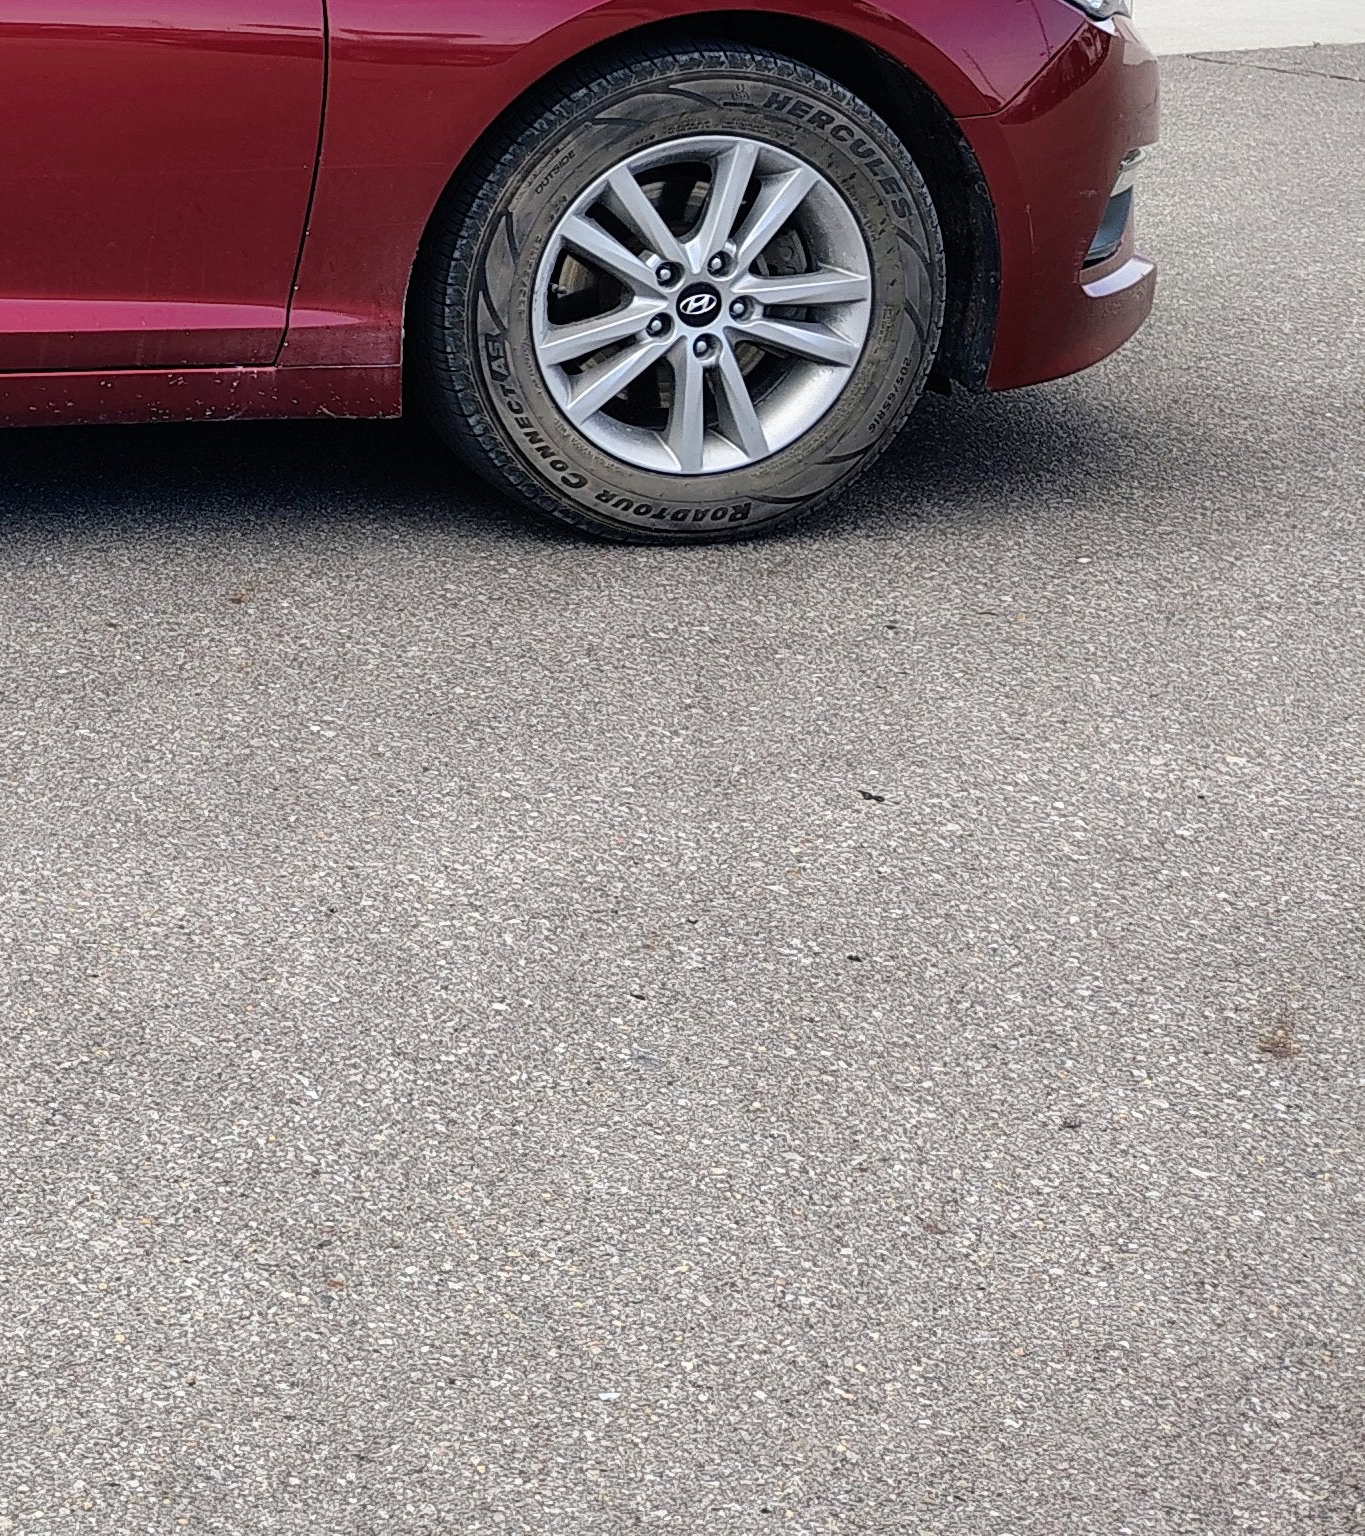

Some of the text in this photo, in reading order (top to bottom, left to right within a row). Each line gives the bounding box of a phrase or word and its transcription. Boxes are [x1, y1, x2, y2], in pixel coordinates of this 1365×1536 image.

[534, 149, 576, 195] OUTSIDE
[763, 91, 912, 219] HERCULES
[868, 357, 912, 433] 205/65R16
[499, 382, 589, 490] CONNECT
[594, 488, 753, 523] ROADTOUR
